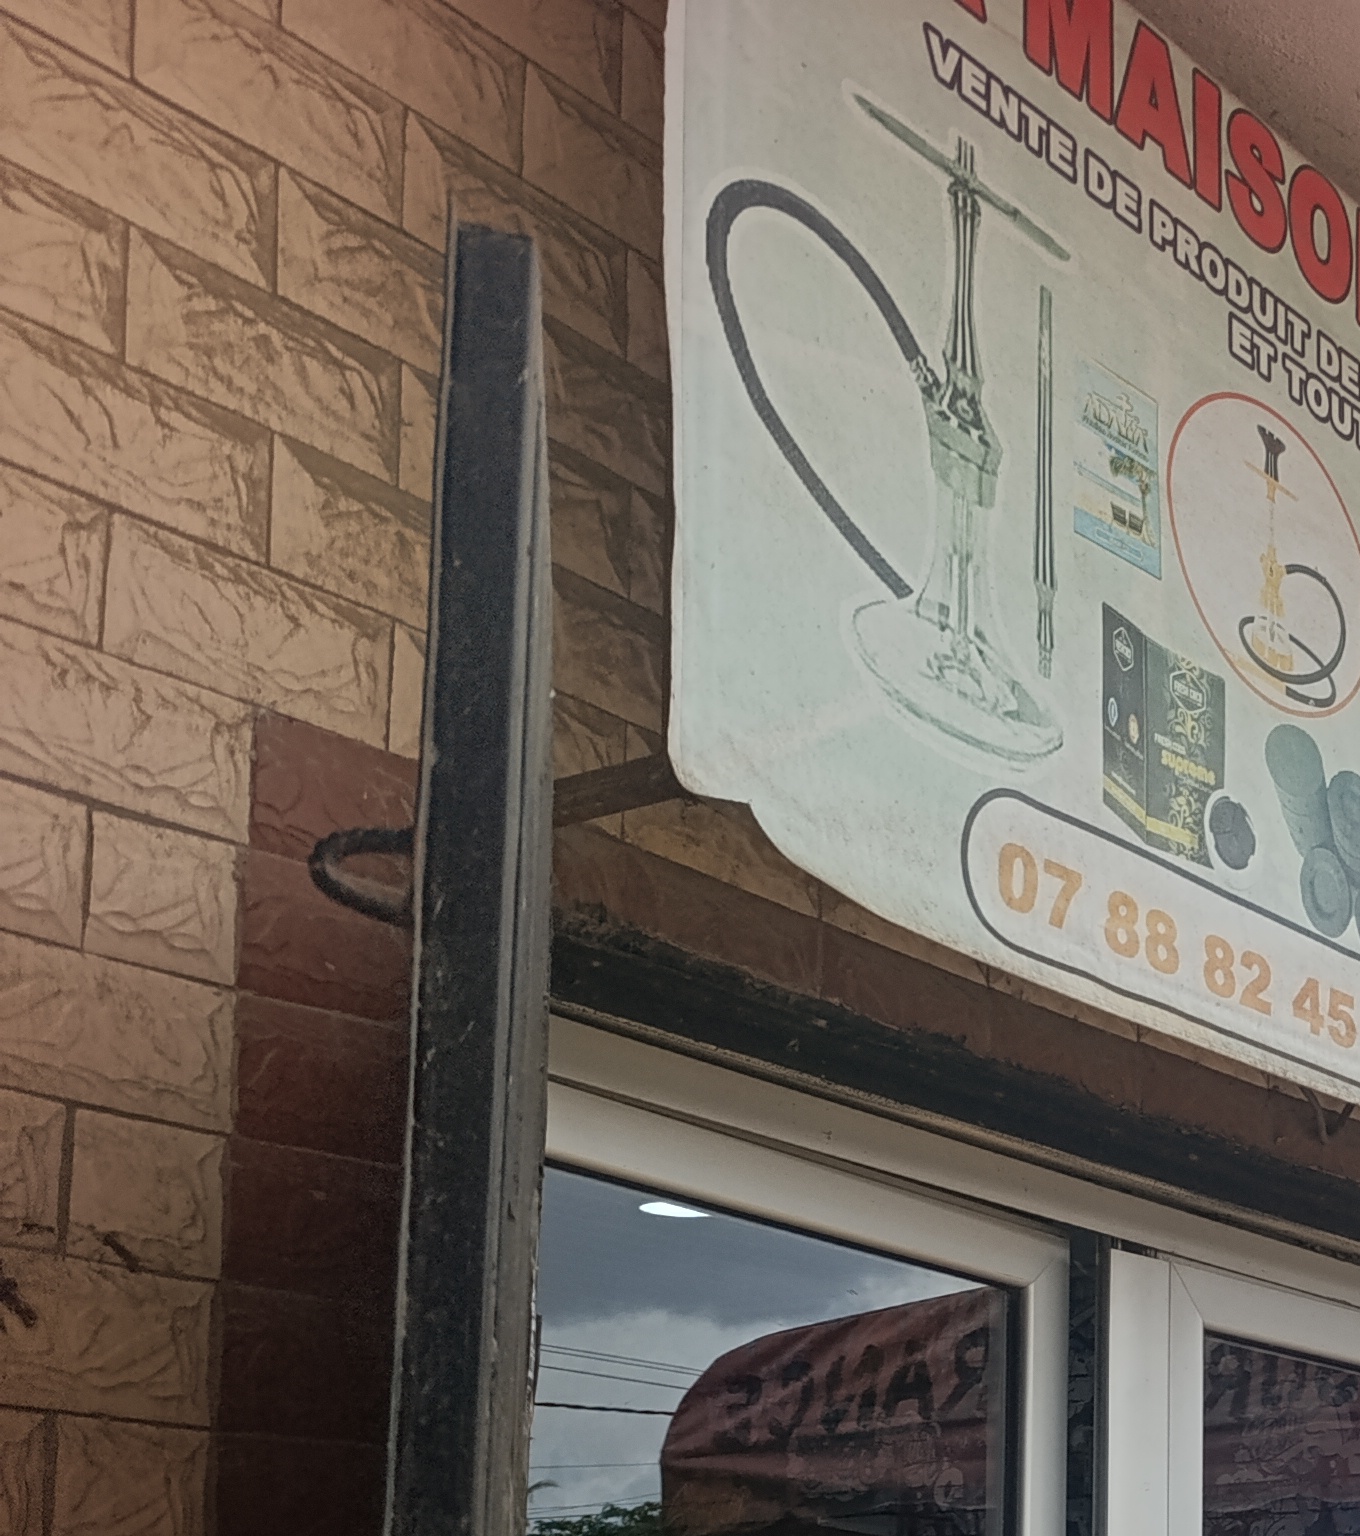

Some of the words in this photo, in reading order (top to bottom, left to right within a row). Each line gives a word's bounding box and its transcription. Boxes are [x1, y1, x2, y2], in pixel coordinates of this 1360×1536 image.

[923, 22, 1077, 184] VENTE
[1083, 148, 1141, 234] DE
[1149, 195, 1310, 357] PRODUIT
[1228, 311, 1275, 382] ET
[996, 841, 1083, 930] 07
[1103, 889, 1181, 976] 88
[1202, 934, 1273, 1017] 82
[1292, 977, 1357, 1050] 45
